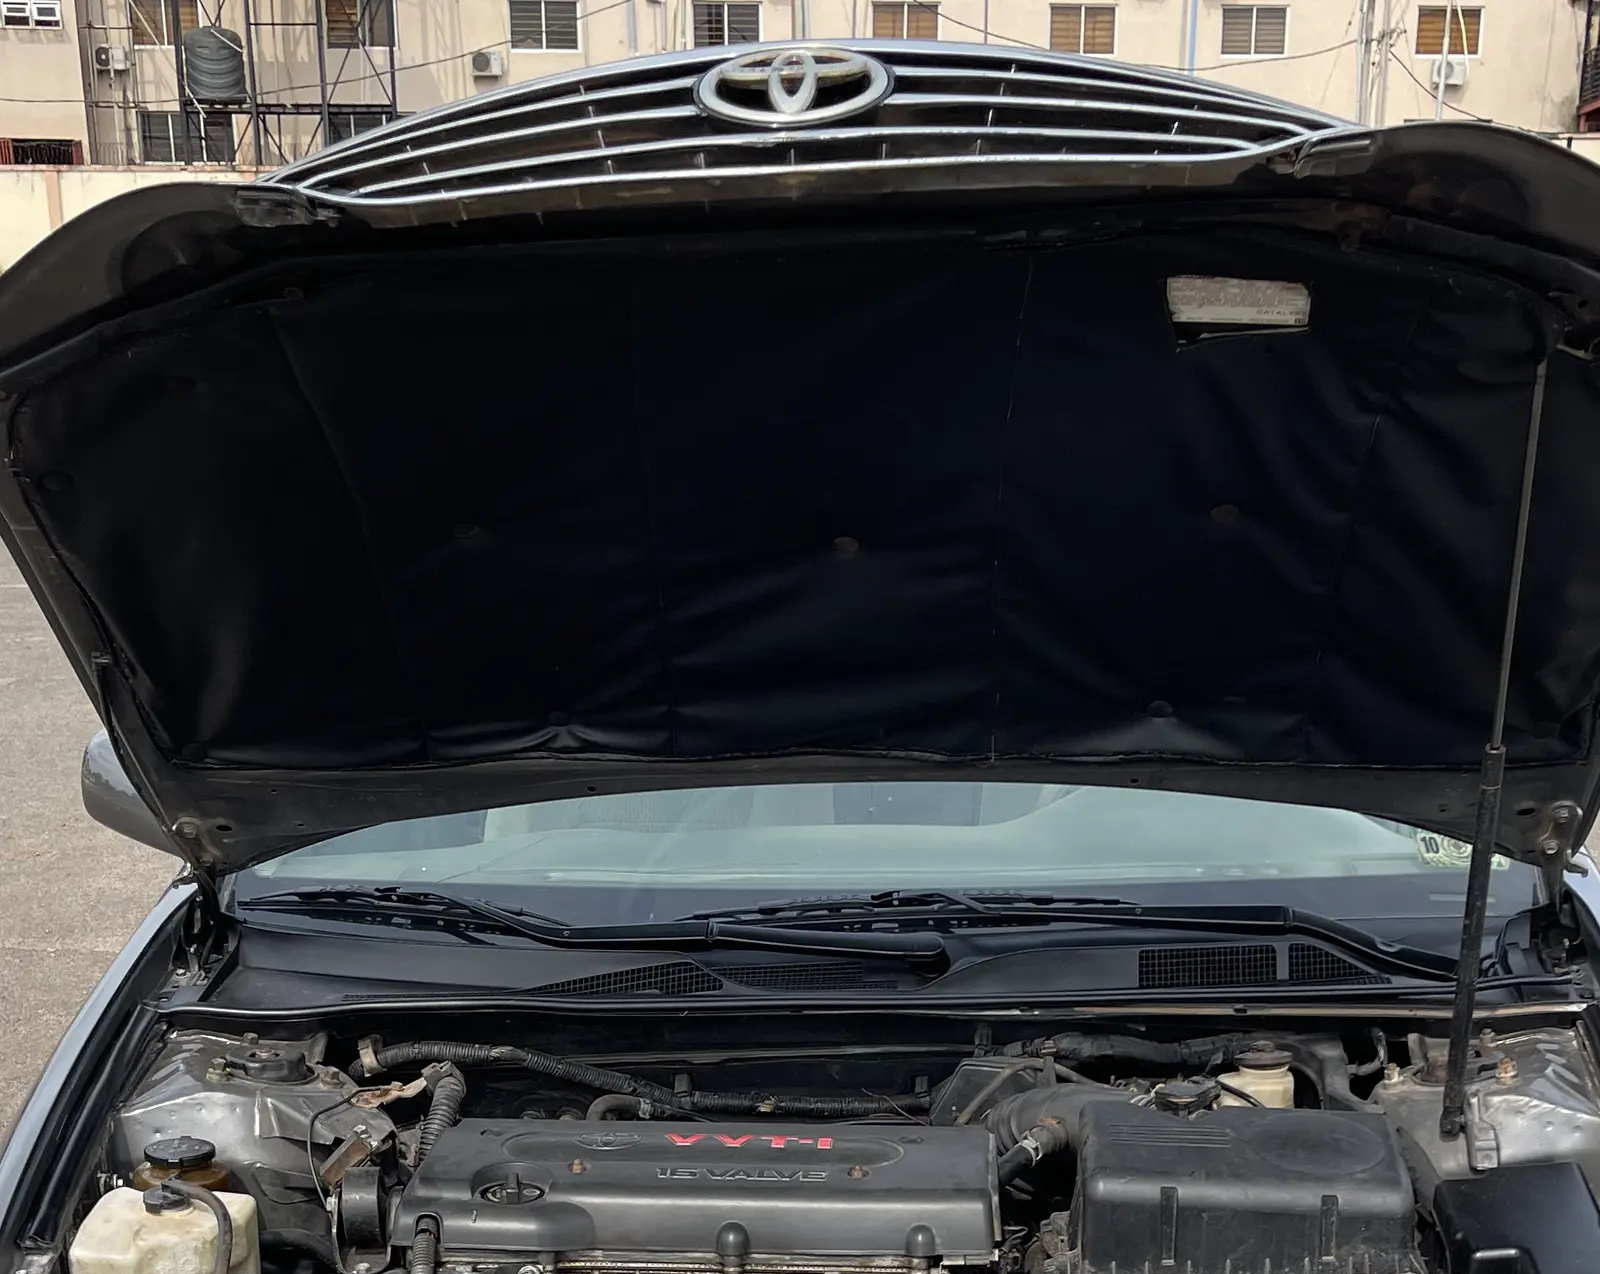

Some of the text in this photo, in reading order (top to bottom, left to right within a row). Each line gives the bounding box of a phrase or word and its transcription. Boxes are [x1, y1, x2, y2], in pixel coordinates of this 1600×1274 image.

[1420, 836, 1440, 854] 10
[655, 1167, 828, 1182] 16 VALVE
